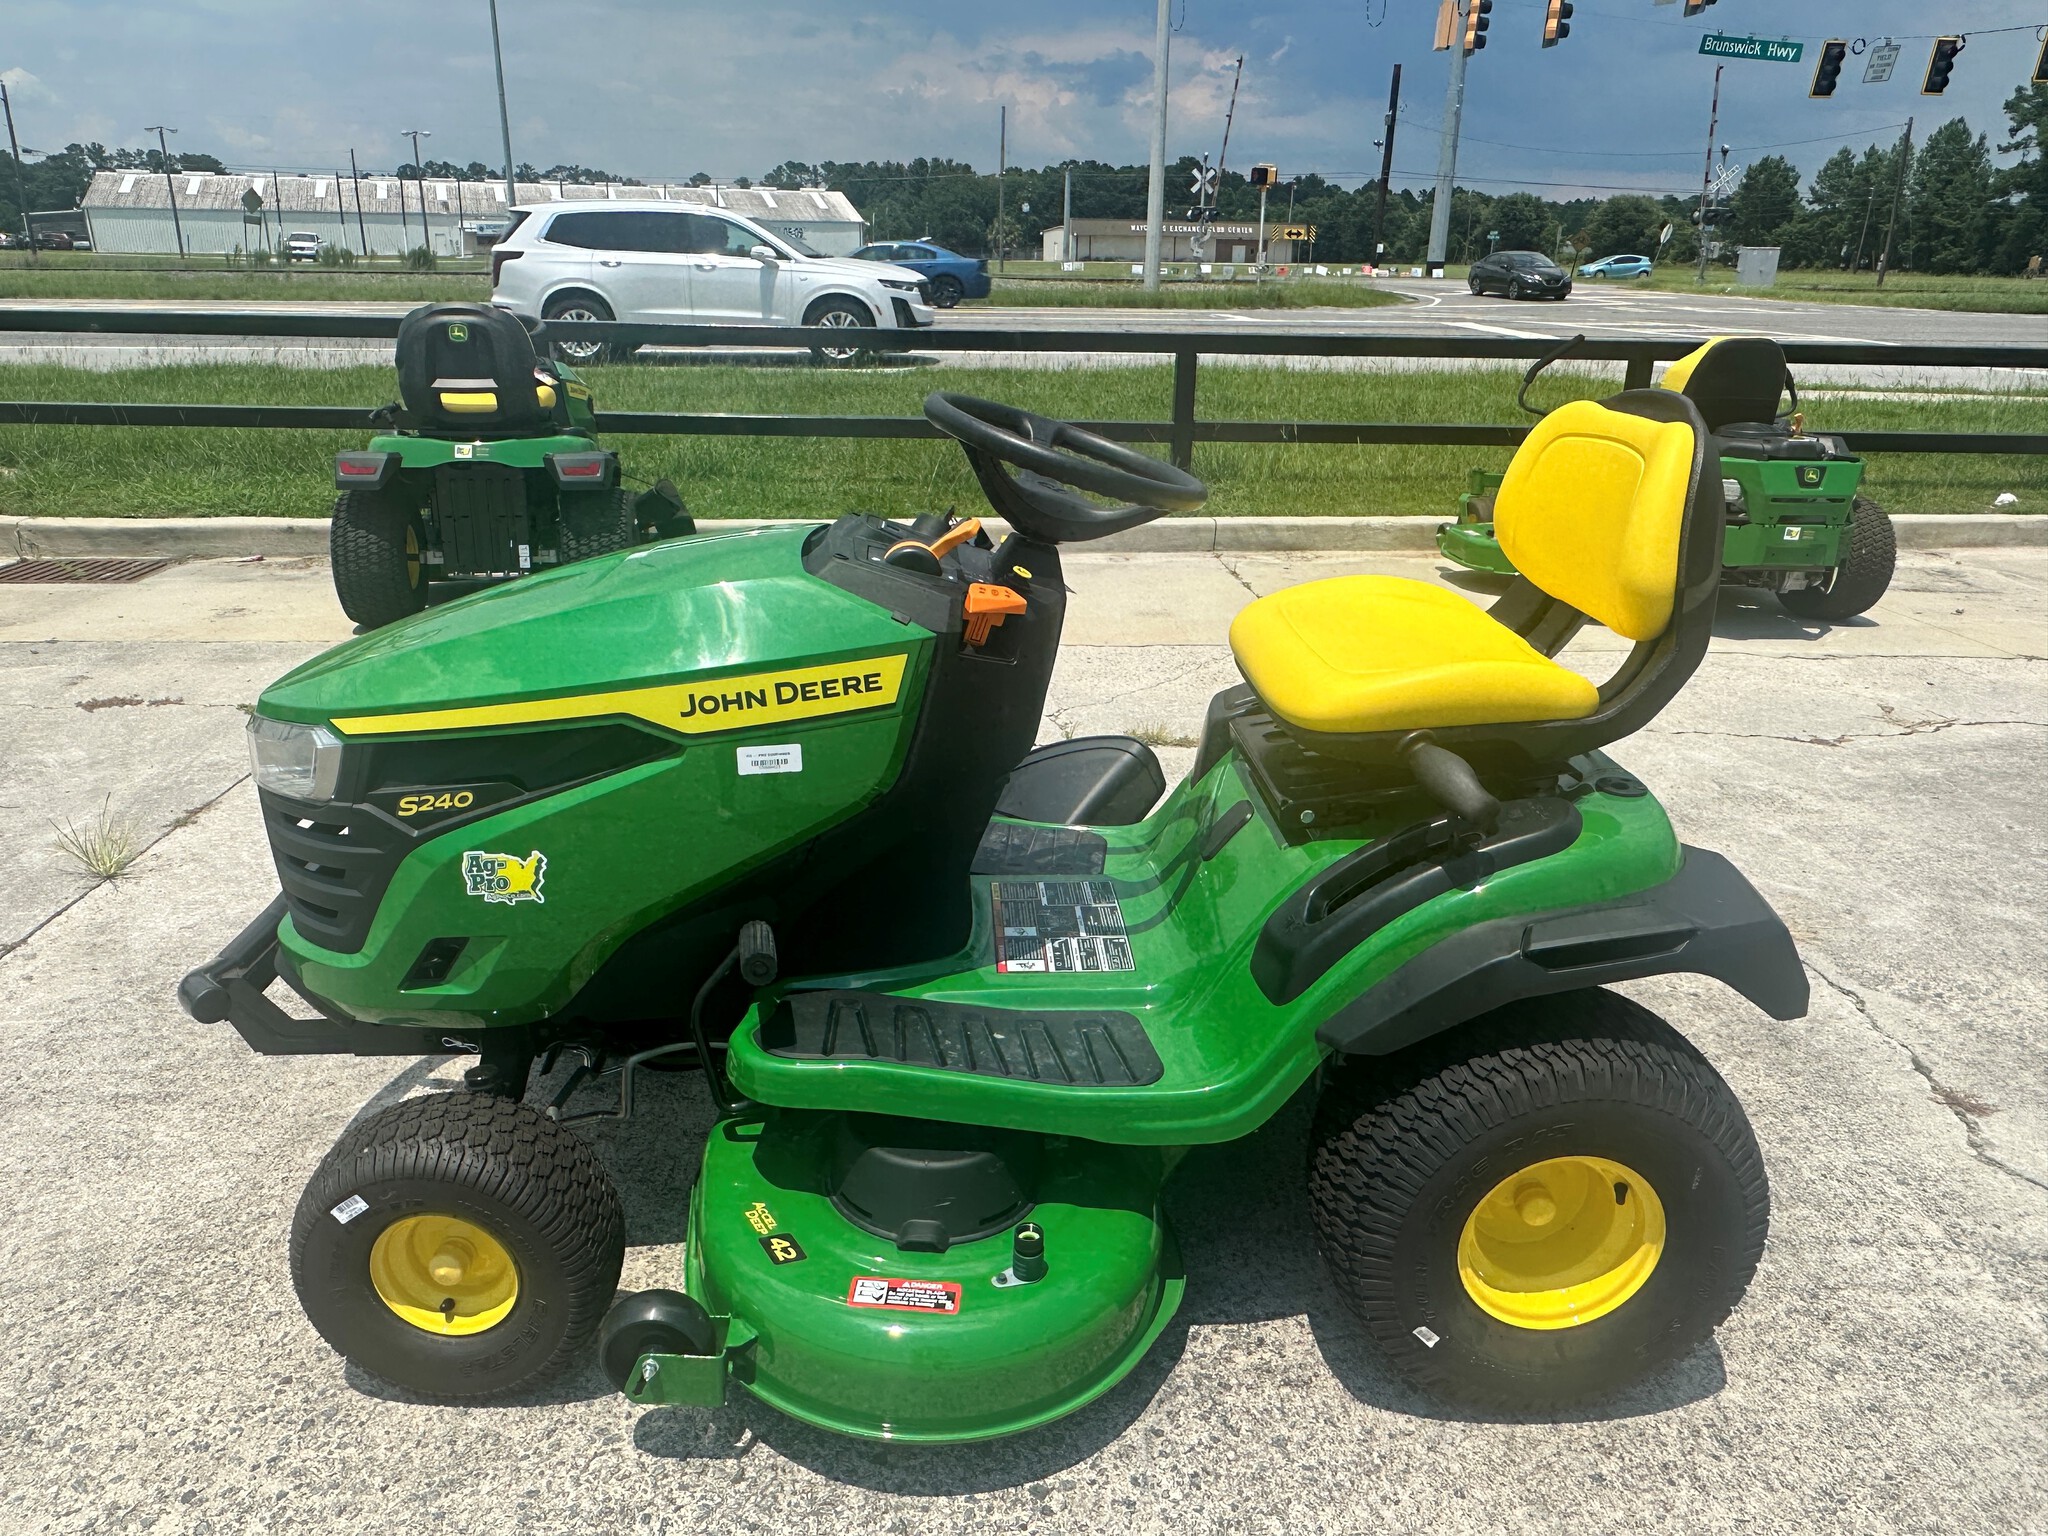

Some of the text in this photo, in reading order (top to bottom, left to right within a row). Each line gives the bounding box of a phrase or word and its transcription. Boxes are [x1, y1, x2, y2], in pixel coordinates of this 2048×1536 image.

[1704, 37, 1797, 61] Brunswick Hwy
[1227, 226, 1253, 234] CENTER
[680, 672, 883, 718] JOHN DEERE
[398, 791, 474, 817] S240
[467, 854, 507, 877] Ag-
[469, 873, 510, 893] Pro
[745, 1209, 769, 1235] DEEP
[752, 1202, 777, 1230] ACCEL
[770, 1238, 797, 1261] 42
